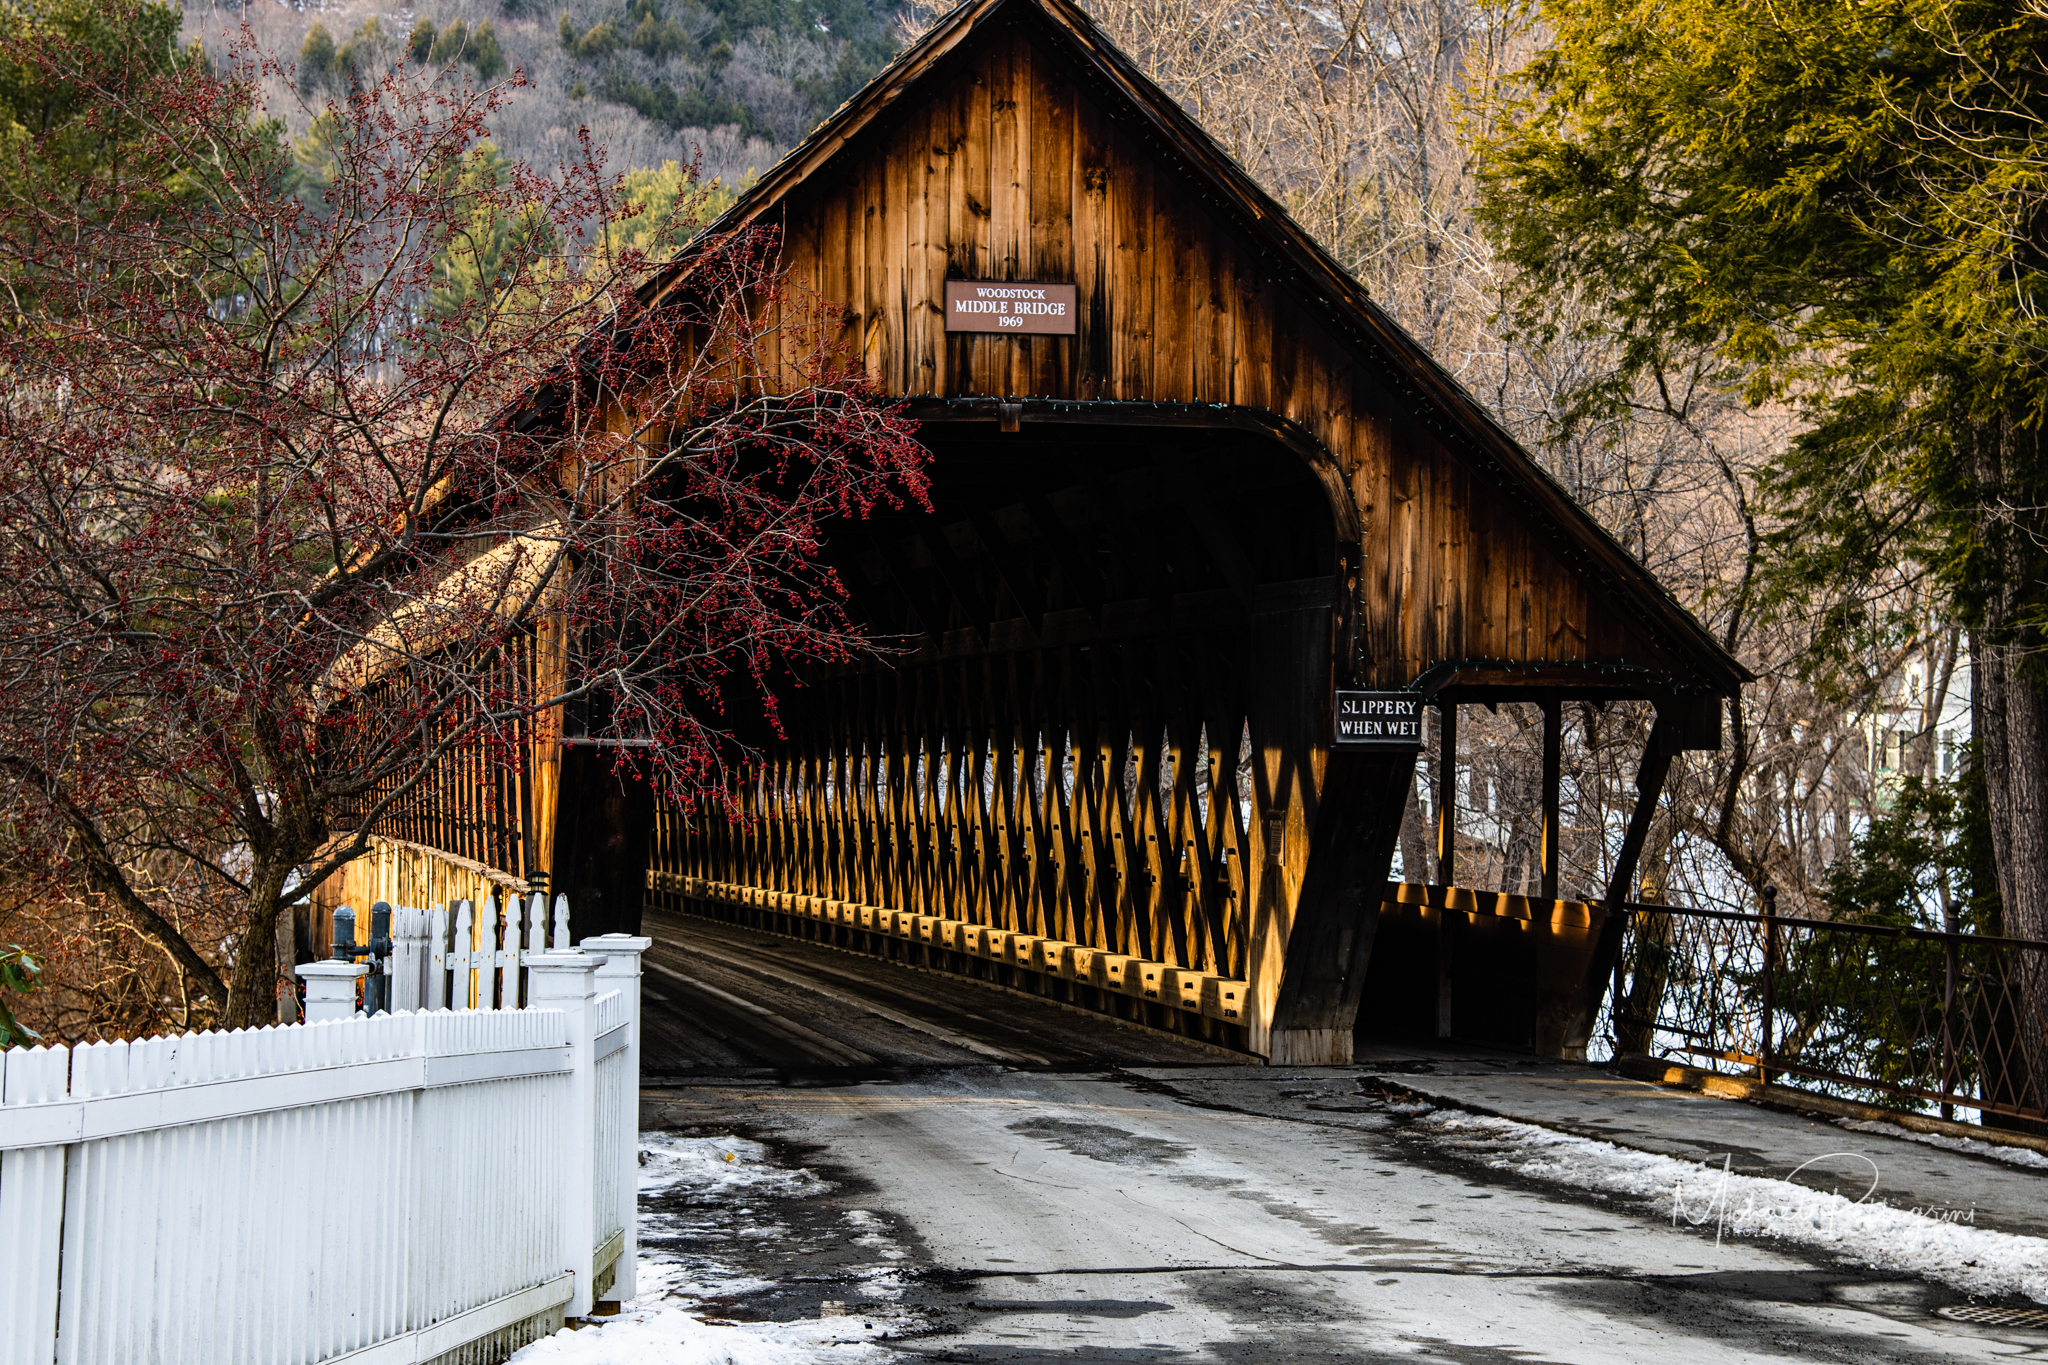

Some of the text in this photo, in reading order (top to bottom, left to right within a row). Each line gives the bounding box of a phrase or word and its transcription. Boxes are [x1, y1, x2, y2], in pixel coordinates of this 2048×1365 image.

[976, 287, 1046, 299] WOODSTOCK
[955, 300, 1066, 315] MIDDLE BRIDGE
[998, 316, 1023, 327] 1969
[1341, 700, 1417, 714] SLIPPERY
[1340, 721, 1419, 736] WHEN WET
